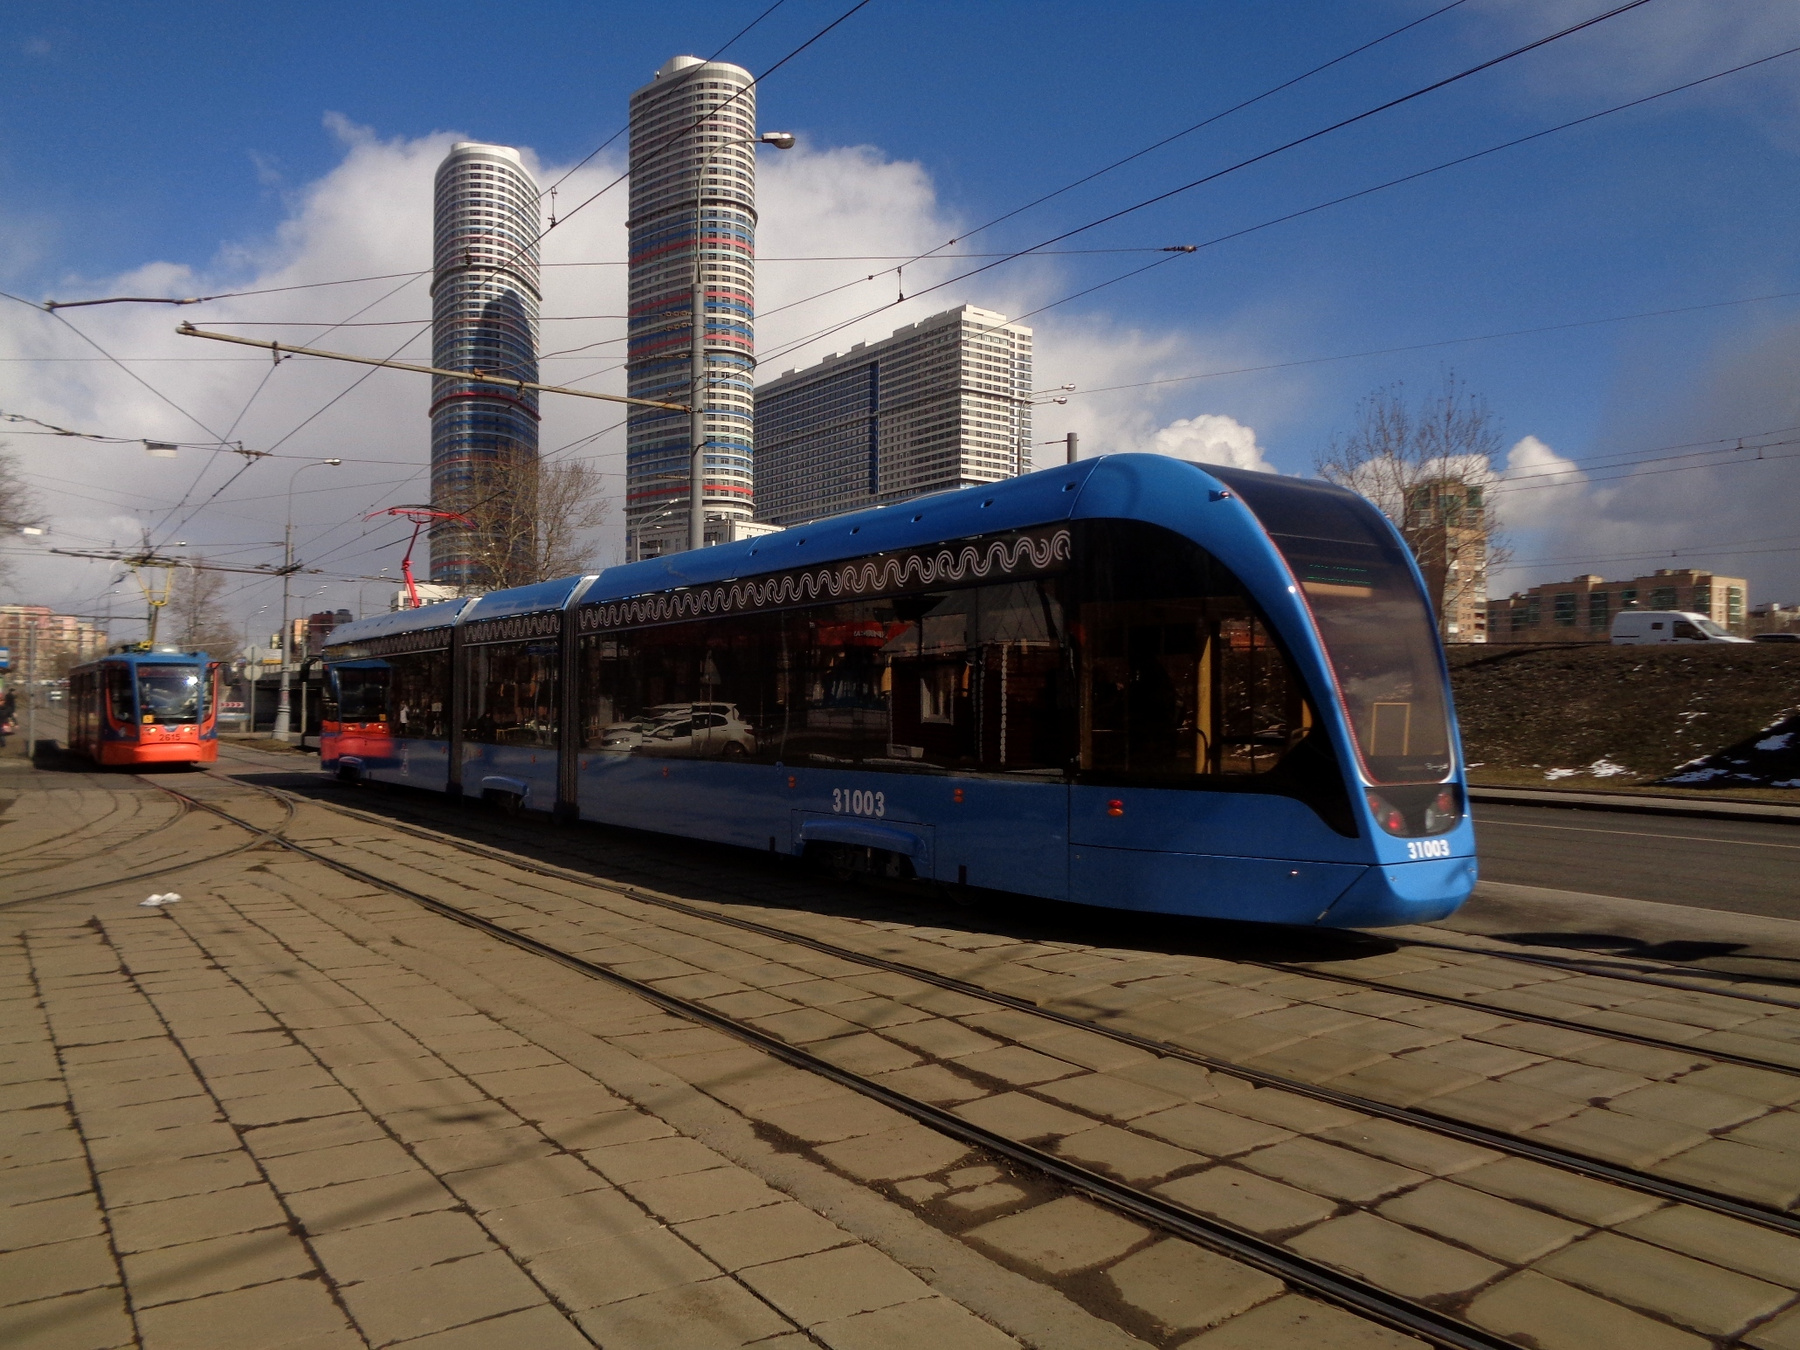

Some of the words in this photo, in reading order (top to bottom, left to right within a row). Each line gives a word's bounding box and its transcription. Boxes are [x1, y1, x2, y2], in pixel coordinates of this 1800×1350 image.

[159, 733, 181, 742] 2615
[832, 788, 885, 817] 31003
[1407, 839, 1450, 859] 31003
